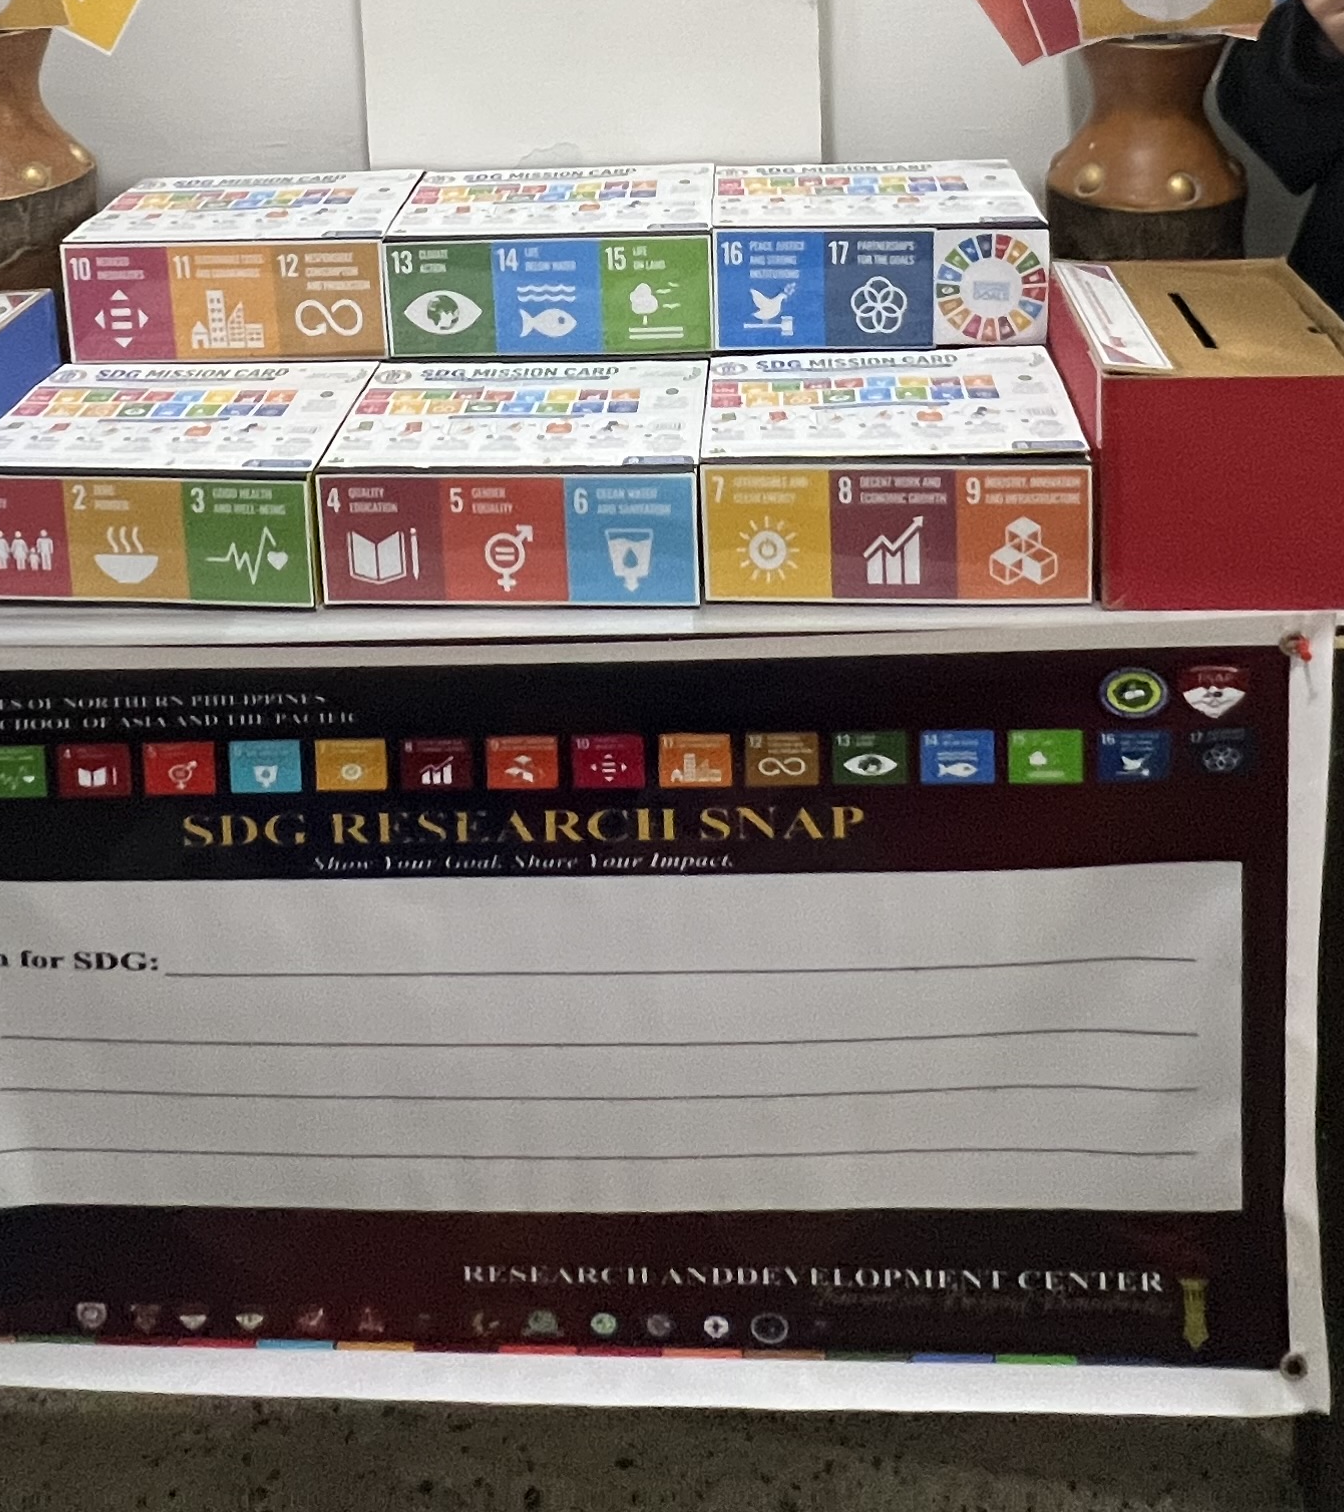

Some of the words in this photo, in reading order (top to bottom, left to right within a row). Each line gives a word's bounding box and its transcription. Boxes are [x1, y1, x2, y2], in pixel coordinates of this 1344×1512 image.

[173, 177, 214, 187] SDG
[219, 176, 293, 186] MISSION
[298, 174, 346, 185] CARD
[462, 174, 504, 183] SDG
[509, 170, 583, 180] MISSION
[585, 167, 638, 178] CARD
[756, 167, 799, 176] SDG
[801, 164, 878, 173] MISSION
[881, 163, 932, 172] CARD
[391, 250, 413, 274] 13
[496, 248, 518, 271] 14
[605, 246, 627, 271] 15
[721, 241, 743, 266] 16
[828, 240, 849, 265] 17
[69, 257, 91, 281] 10
[172, 255, 191, 279] 11
[276, 253, 299, 278] 12
[421, 368, 469, 380] SDG
[473, 367, 558, 379] MISSION
[563, 366, 620, 378] CARD
[756, 359, 802, 372] SDG
[808, 356, 898, 370] MISSION
[901, 353, 958, 367] CARD
[96, 368, 146, 382] SDG
[147, 367, 232, 380] MISSION
[233, 367, 290, 380] CARD
[72, 485, 87, 510] 2
[191, 487, 205, 513] 3
[326, 487, 341, 513] 4
[450, 487, 464, 513] 5
[573, 488, 589, 514] 6
[712, 476, 725, 503] 7
[838, 476, 852, 504] 8
[966, 476, 981, 504] 9
[63, 695, 183, 709] NORTHERN
[191, 694, 326, 707] PHILIPPINES
[122, 715, 167, 728] ASIA
[176, 715, 219, 727] AND
[576, 737, 590, 750] 10
[749, 736, 762, 749] 12
[836, 734, 851, 748] 13
[923, 734, 938, 746] 14
[1101, 732, 1115, 746] 16
[64, 748, 72, 759] 4
[183, 813, 308, 849] SDG
[332, 807, 676, 845] RESEARCH
[700, 805, 866, 842] SNAP
[384, 854, 433, 871] Your
[514, 853, 578, 870] Share
[589, 853, 643, 869] Your
[20, 949, 65, 970] for
[74, 951, 159, 972] SDG:
[463, 1265, 648, 1285] RESEARCH
[1017, 1268, 1164, 1293] CENTER
